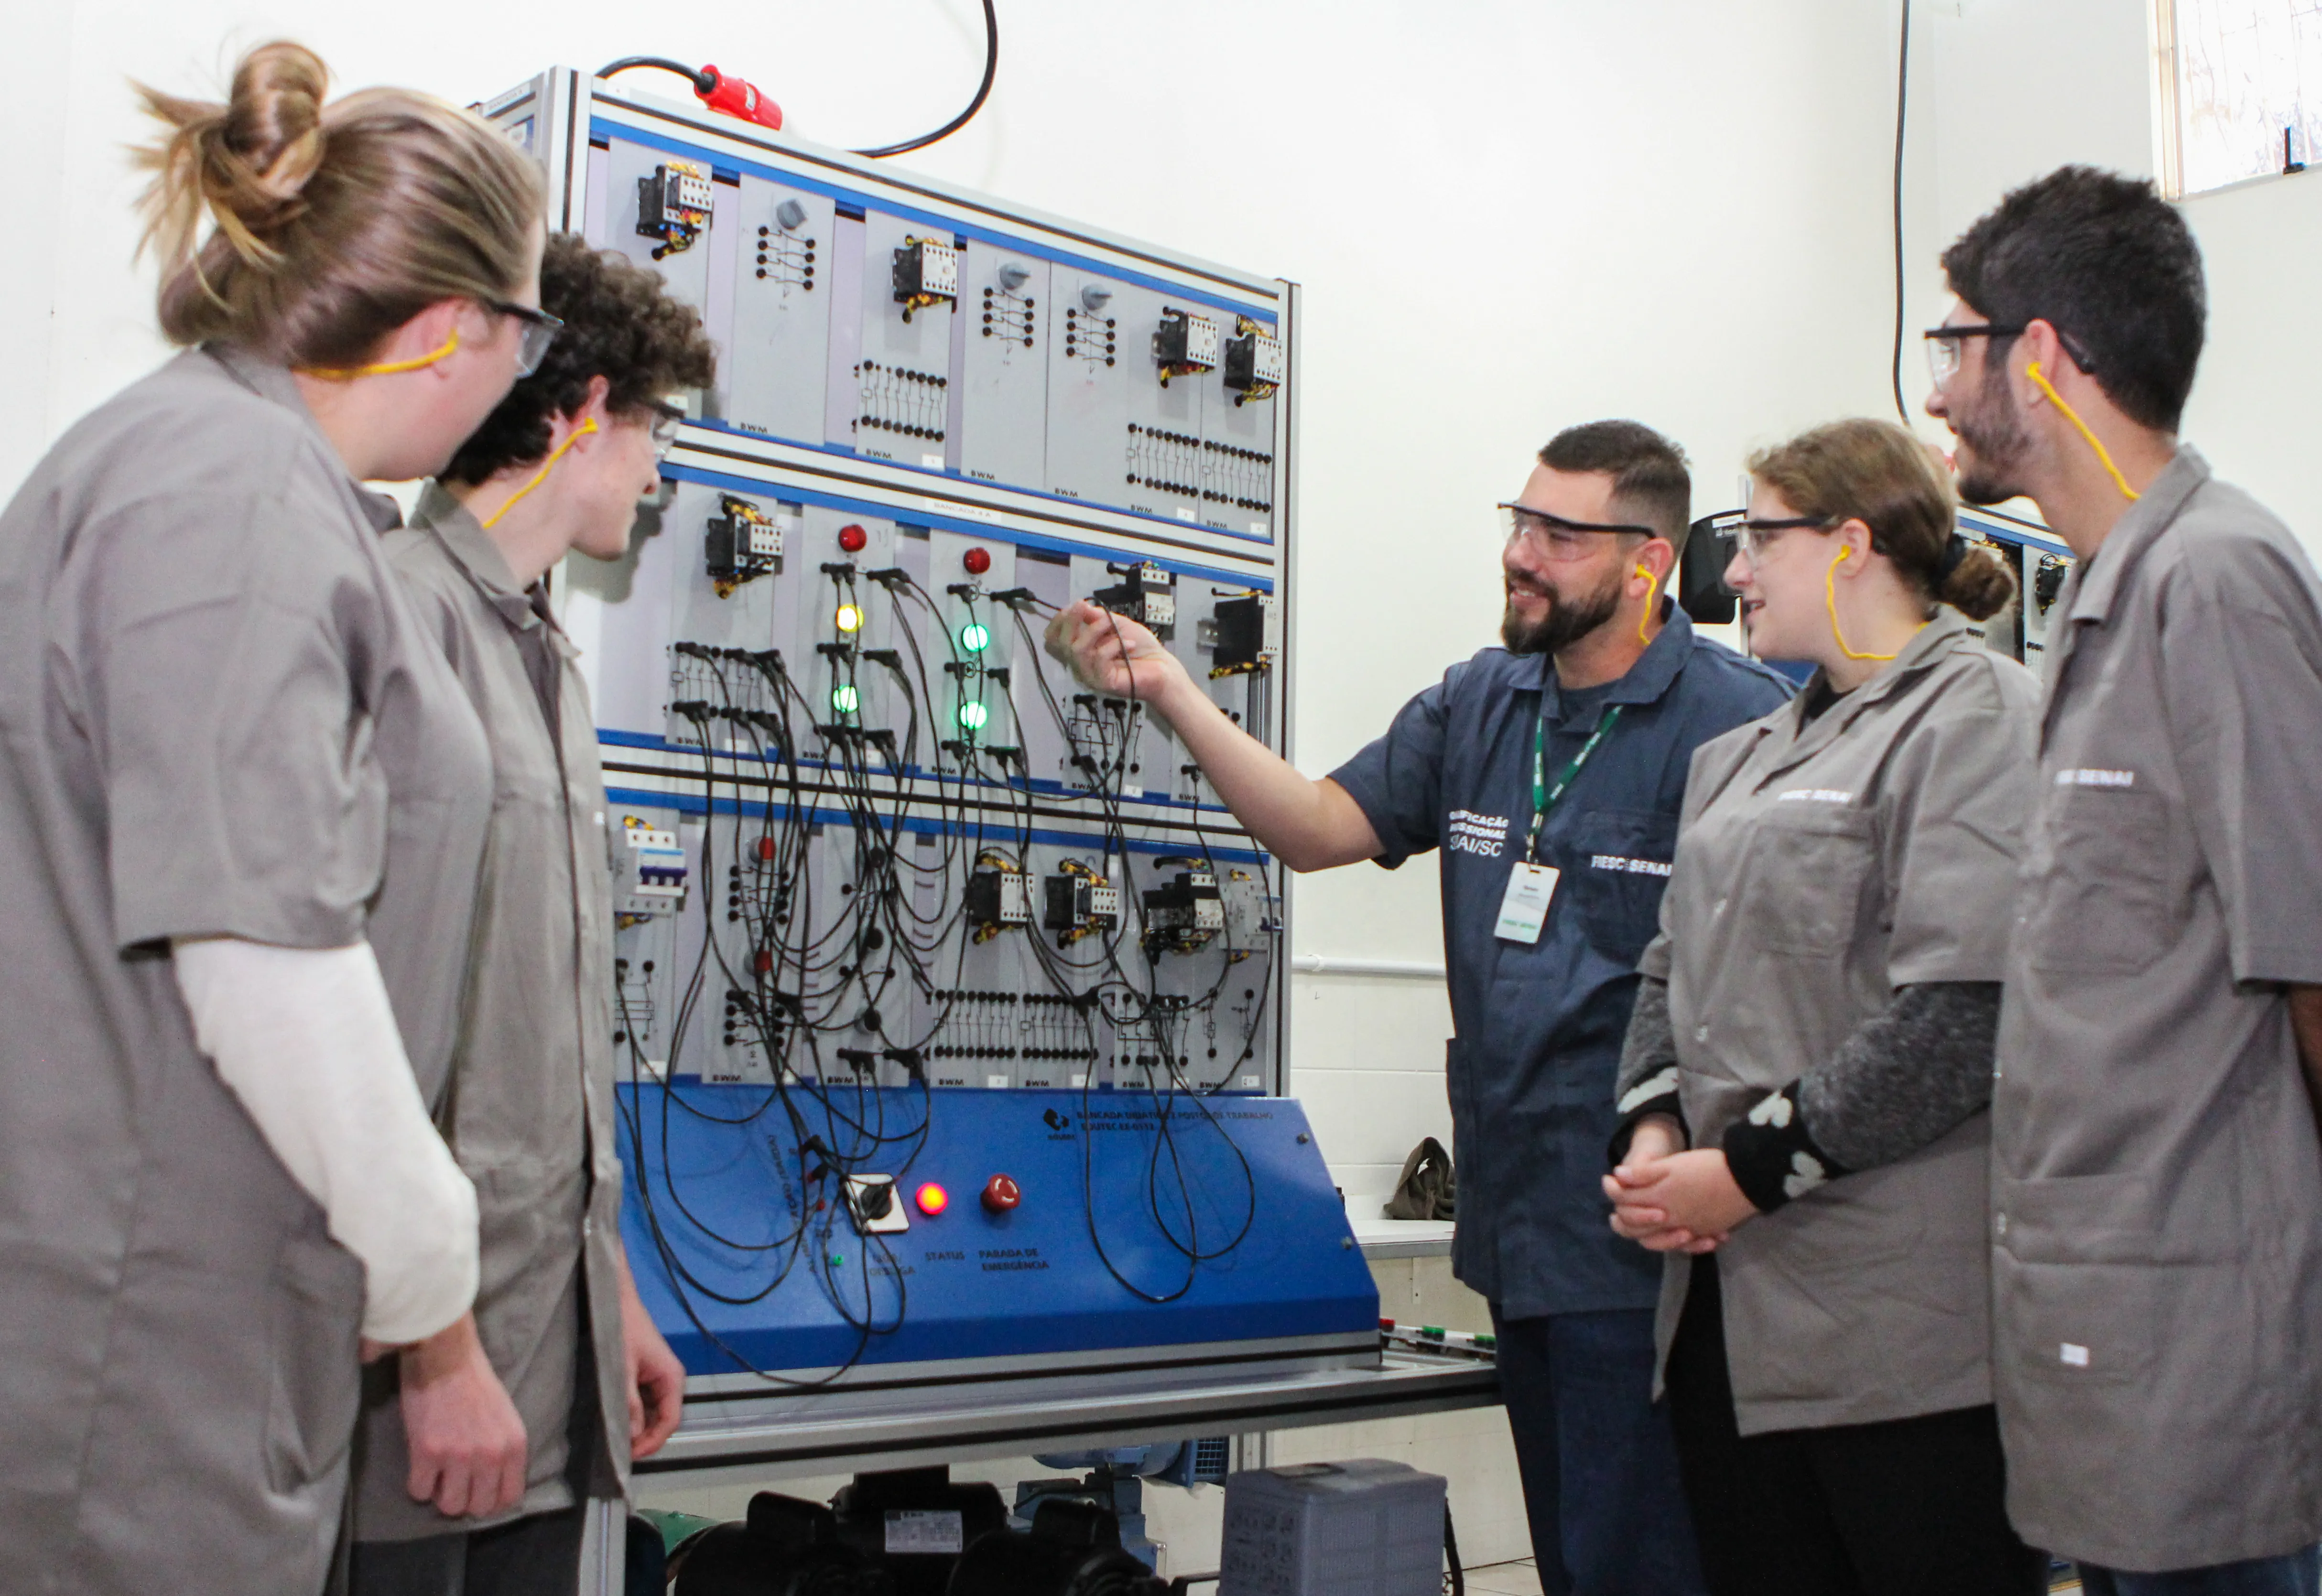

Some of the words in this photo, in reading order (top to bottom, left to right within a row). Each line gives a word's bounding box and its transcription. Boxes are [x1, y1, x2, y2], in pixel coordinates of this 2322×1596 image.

[740, 422, 768, 433] BWM
[866, 448, 892, 459] BWM
[971, 470, 995, 480] BWM
[1055, 488, 1078, 497] BWM
[933, 502, 976, 515] BANCADA
[1131, 504, 1152, 514] BWM
[1206, 519, 1227, 529] BWM
[925, 1251, 966, 1261] STATUS
[978, 1249, 1024, 1258] PARADA
[1025, 1248, 1039, 1257] DE
